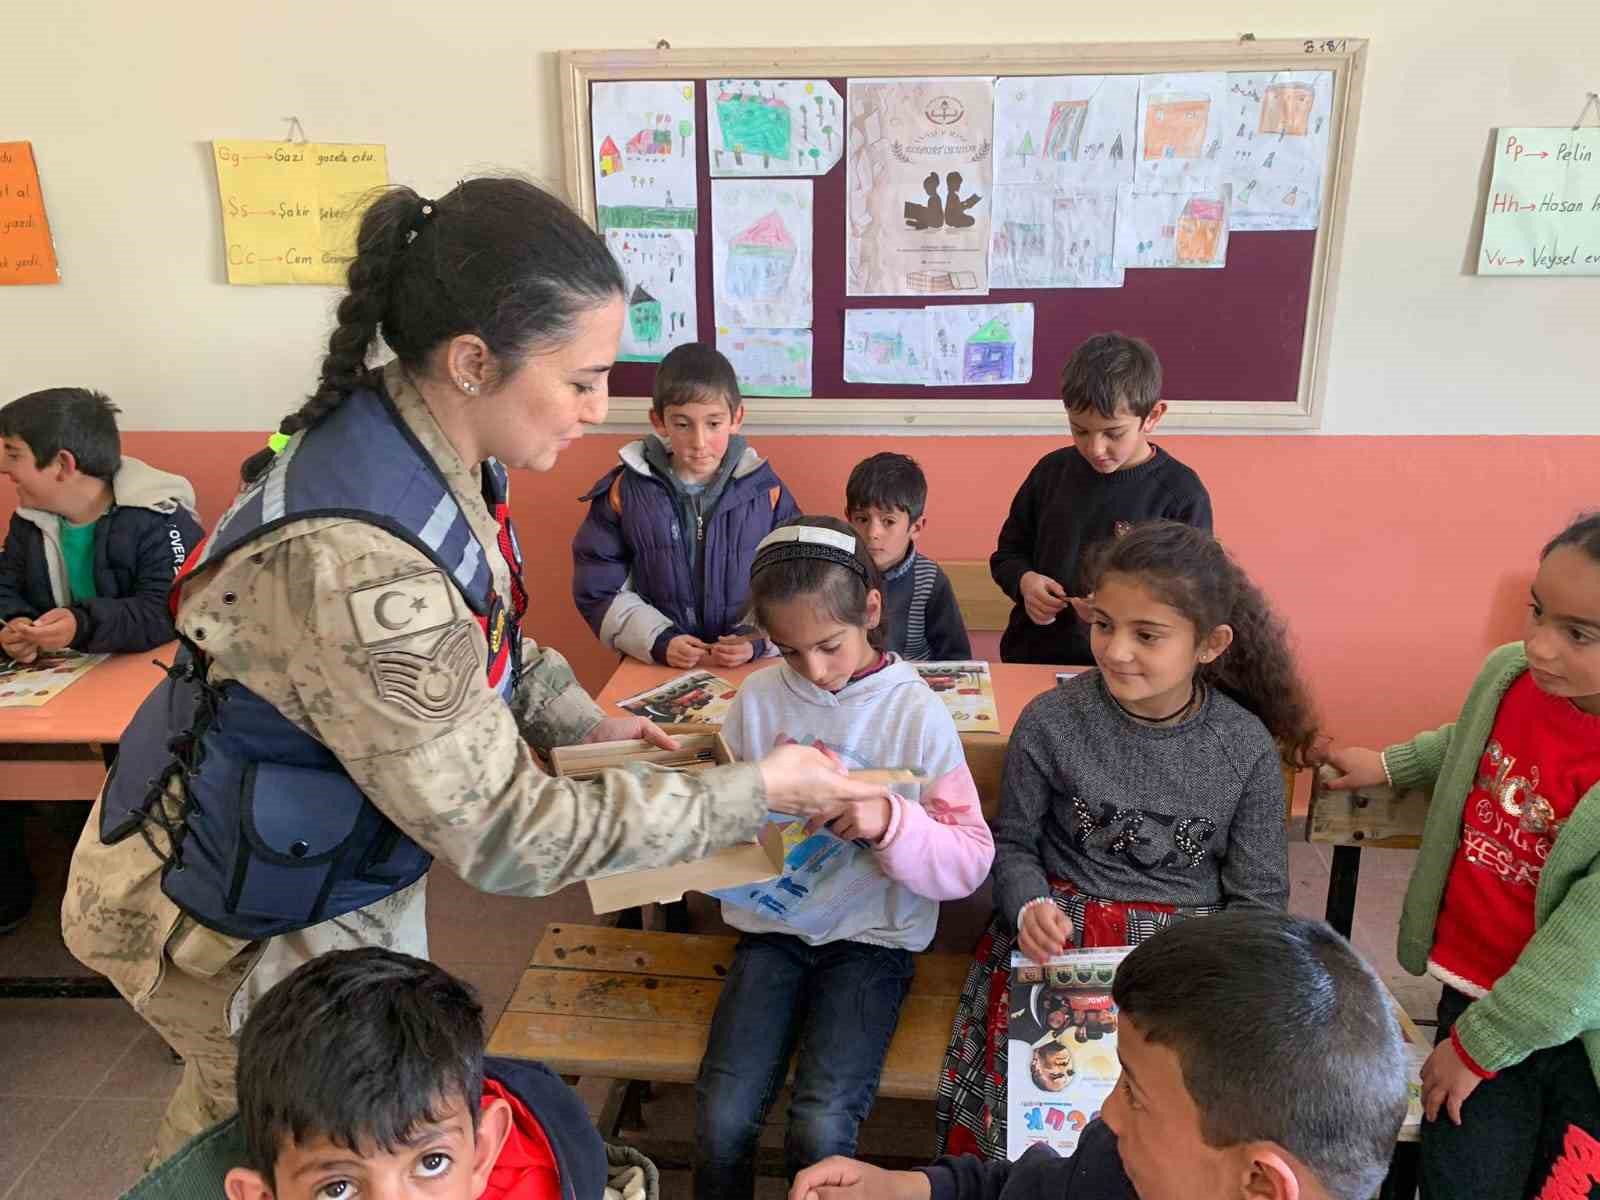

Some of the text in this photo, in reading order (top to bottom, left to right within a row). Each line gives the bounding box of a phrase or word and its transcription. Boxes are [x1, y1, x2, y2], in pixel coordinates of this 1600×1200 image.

[1505, 136, 1592, 163] Pp Pelin
[1492, 193, 1519, 214] Hh
[1532, 245, 1579, 270] Veysel
[1073, 797, 1217, 869] YES
